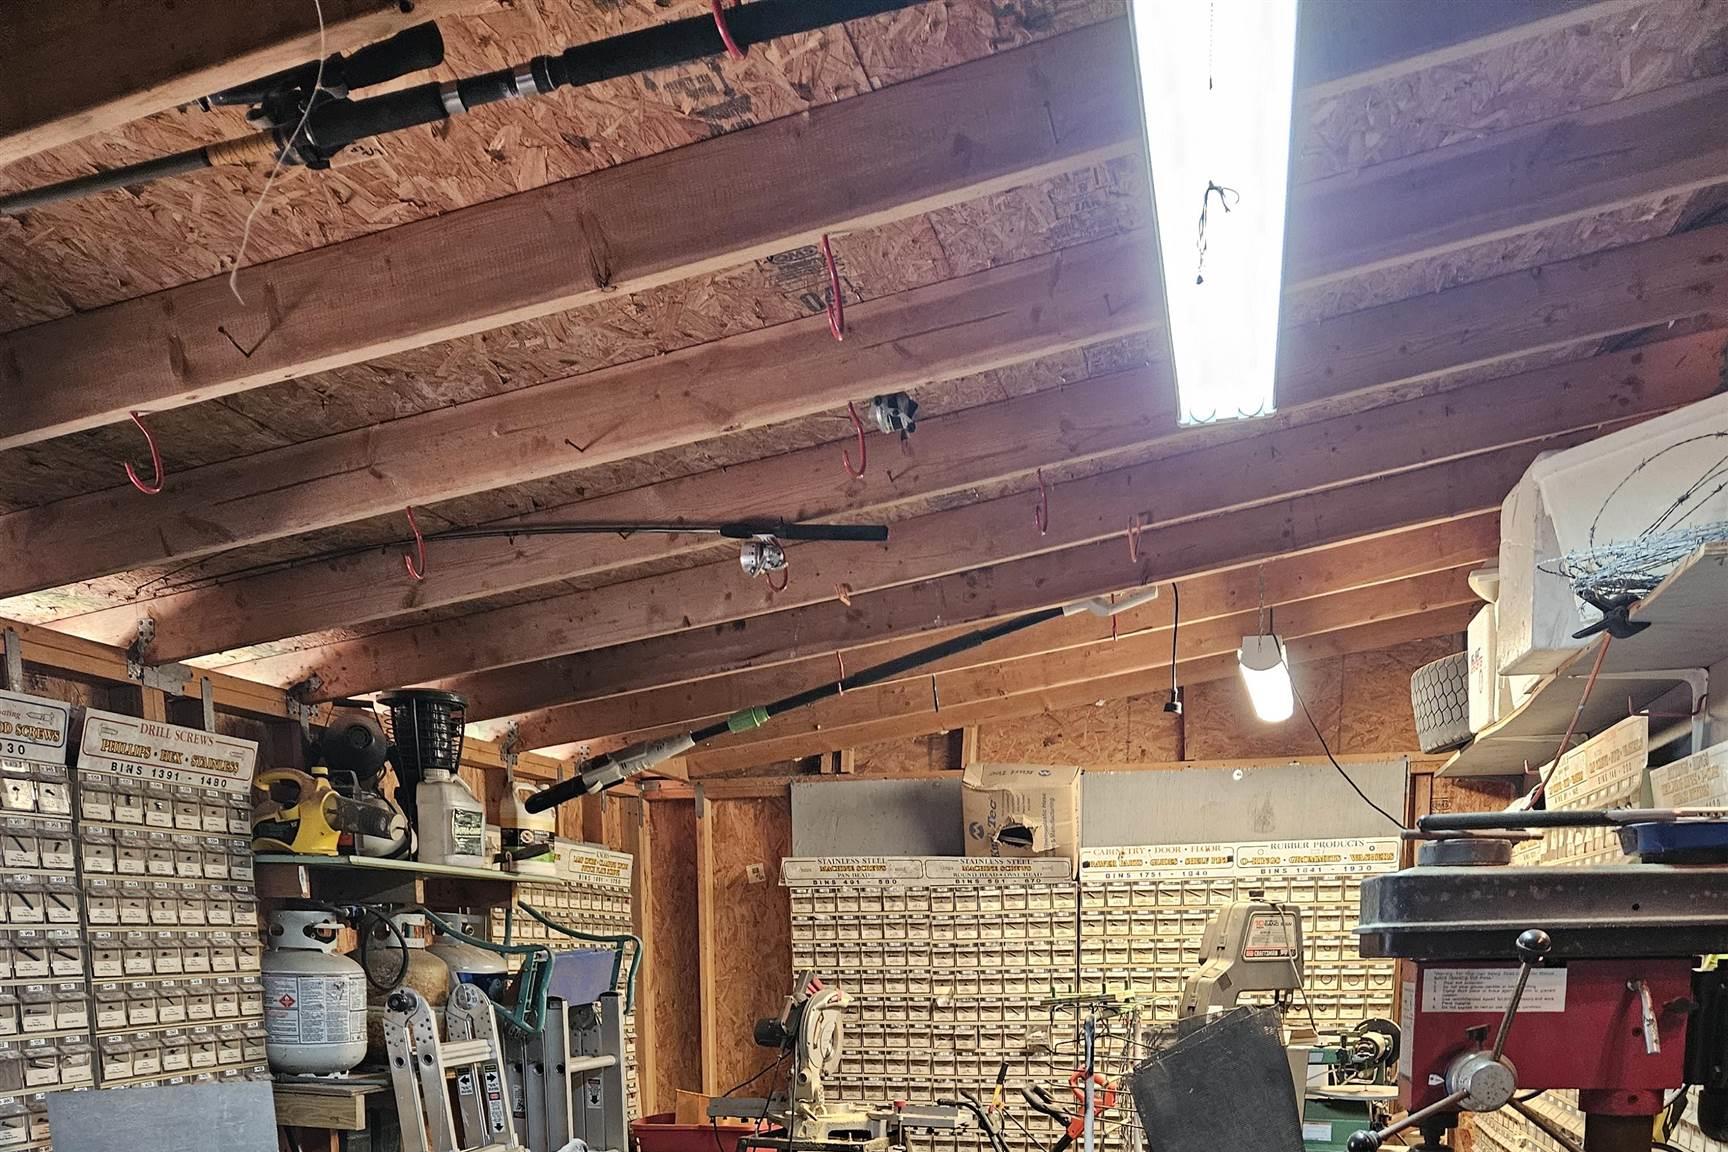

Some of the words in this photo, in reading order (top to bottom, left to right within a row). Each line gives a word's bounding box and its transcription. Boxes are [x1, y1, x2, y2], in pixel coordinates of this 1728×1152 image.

[15, 723, 60, 742] SCREWS
[140, 722, 171, 739] DRILL
[175, 729, 215, 746] SCREWS
[101, 738, 152, 759] PHILLIPS
[110, 761, 143, 775] BINS
[152, 768, 180, 781] 1391
[1270, 841, 1310, 850] RUBBER
[1313, 840, 1365, 849] PRODUCTS
